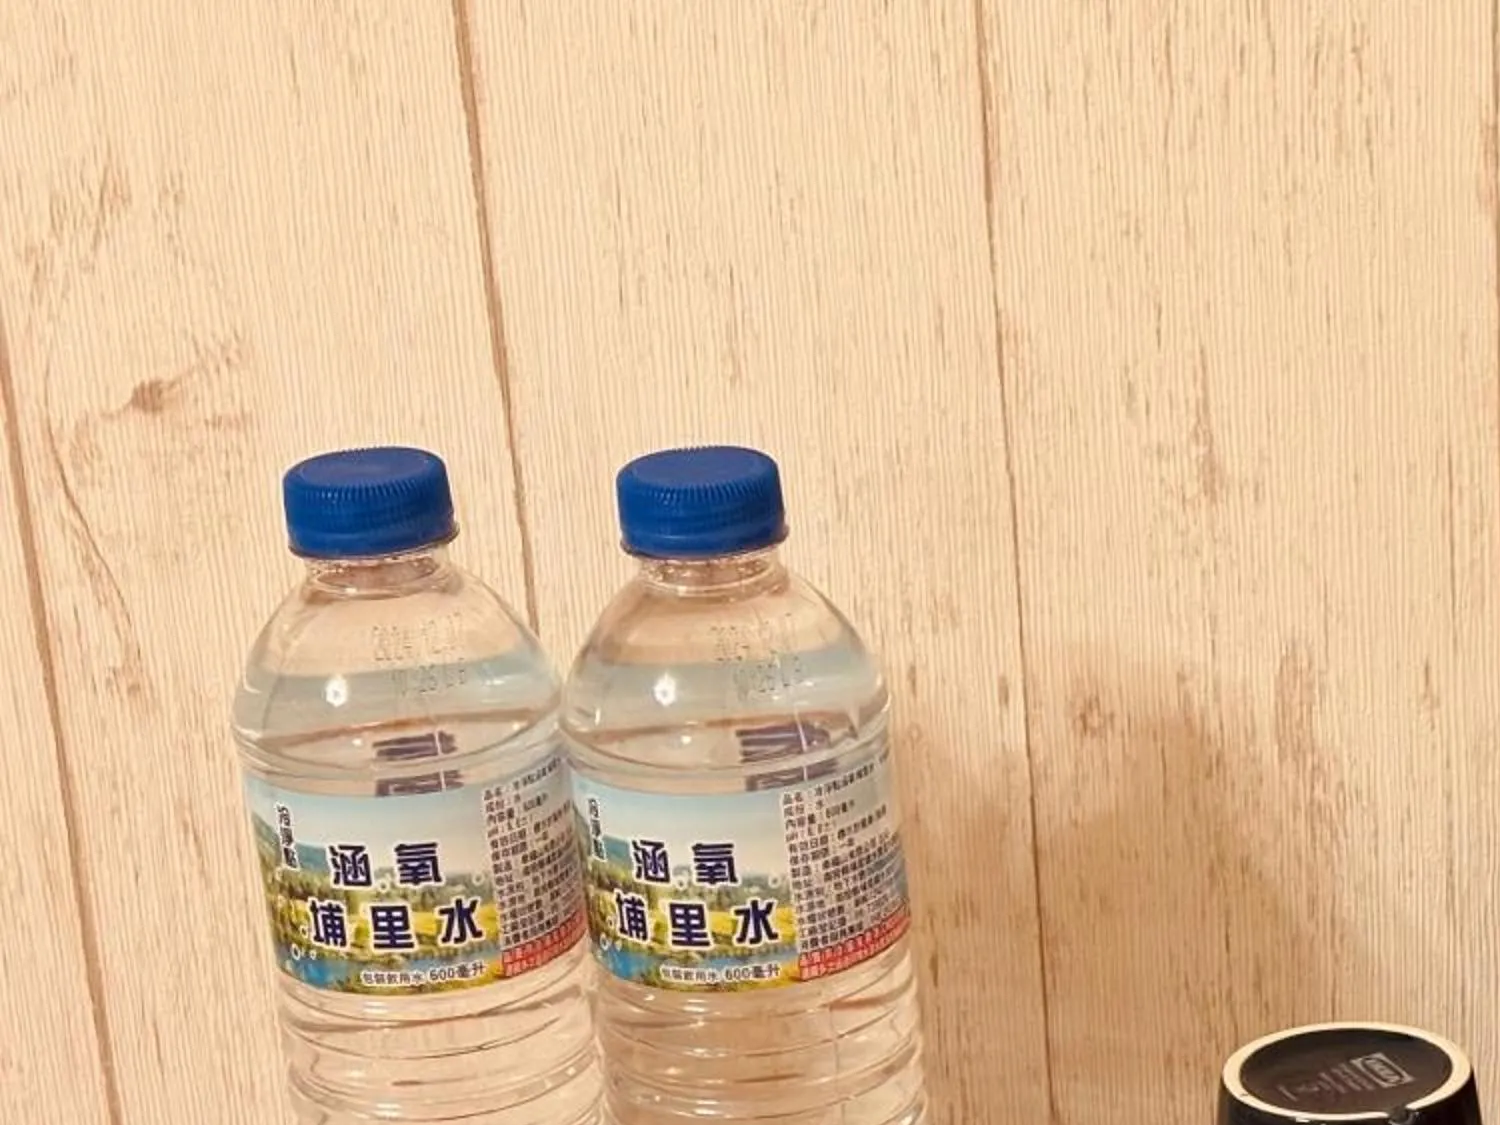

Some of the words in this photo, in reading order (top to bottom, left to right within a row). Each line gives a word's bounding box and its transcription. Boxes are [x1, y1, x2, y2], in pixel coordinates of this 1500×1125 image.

[327, 842, 442, 888] 涵氧
[631, 840, 739, 884] 涵氧
[309, 899, 483, 949] 埔里水
[614, 891, 779, 947] 埔里水
